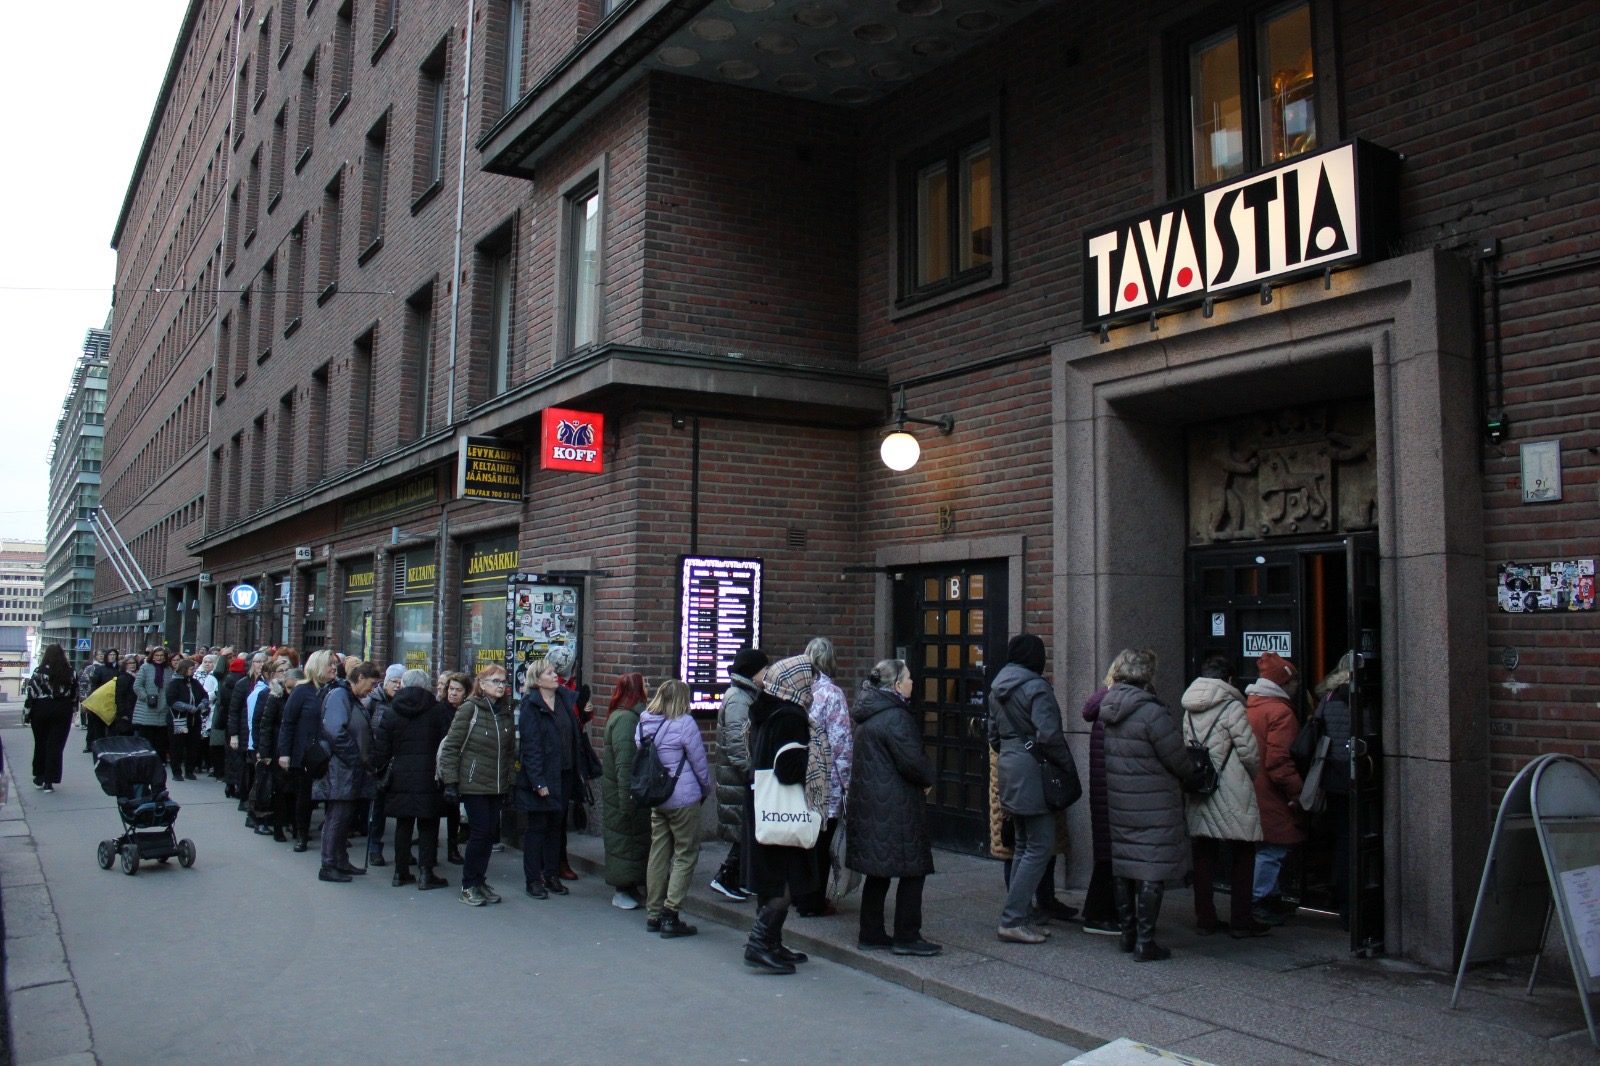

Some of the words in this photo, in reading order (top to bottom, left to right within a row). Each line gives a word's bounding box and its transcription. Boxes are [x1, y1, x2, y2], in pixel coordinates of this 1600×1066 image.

[1089, 159, 1349, 318] TAVASTIA
[467, 446, 522, 462] LEVYKAUPPA
[552, 446, 597, 462] KOFF
[472, 460, 516, 475] KELTAINEN
[465, 468, 520, 486] JÄÄNSÄRKIJÄ
[297, 548, 310, 557] 46
[468, 549, 519, 575] JÄÄNSÄRKIJ
[950, 578, 960, 599] B
[237, 590, 253, 606] W
[1246, 635, 1289, 651] TAVASTIA
[761, 810, 812, 823] knowit
